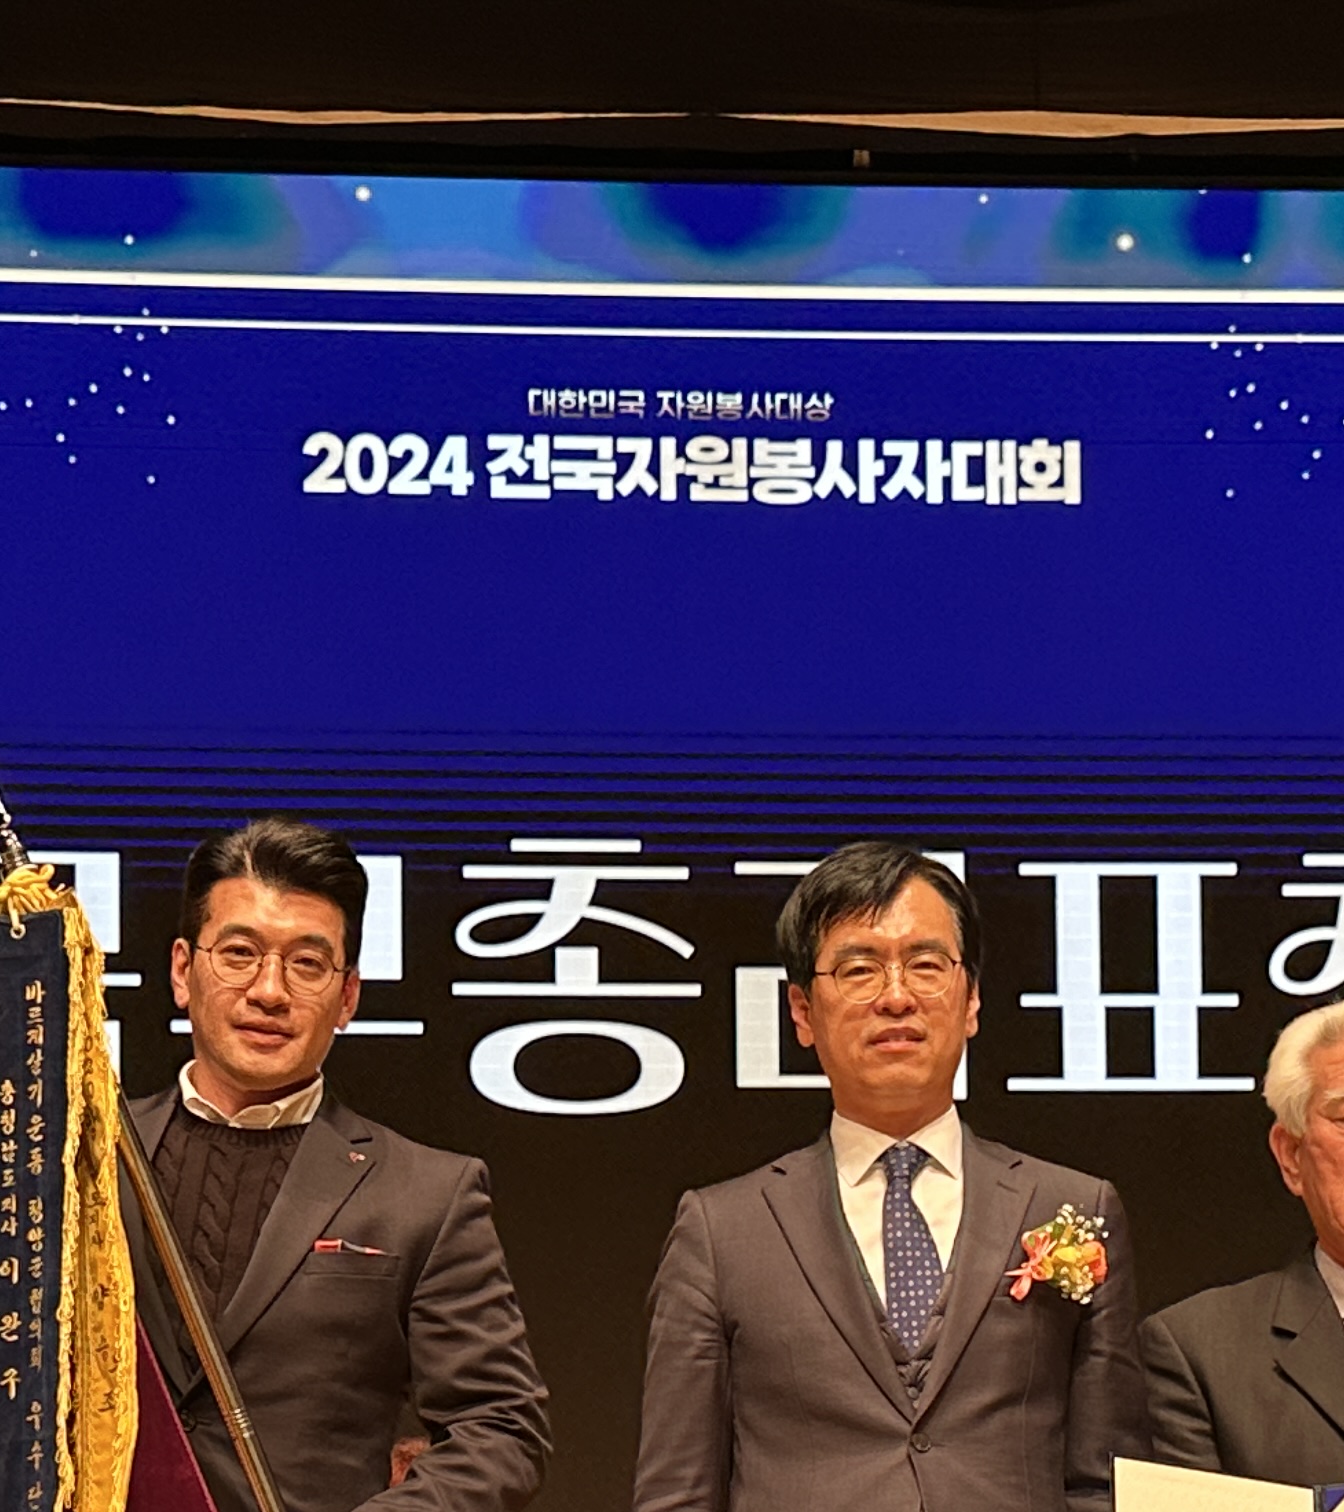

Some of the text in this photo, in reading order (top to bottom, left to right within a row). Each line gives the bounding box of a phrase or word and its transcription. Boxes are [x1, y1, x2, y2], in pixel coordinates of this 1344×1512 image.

[528, 388, 834, 422] 대한민국 자원봉사대상
[302, 432, 1082, 506] 2024 전국자원봉사자대회
